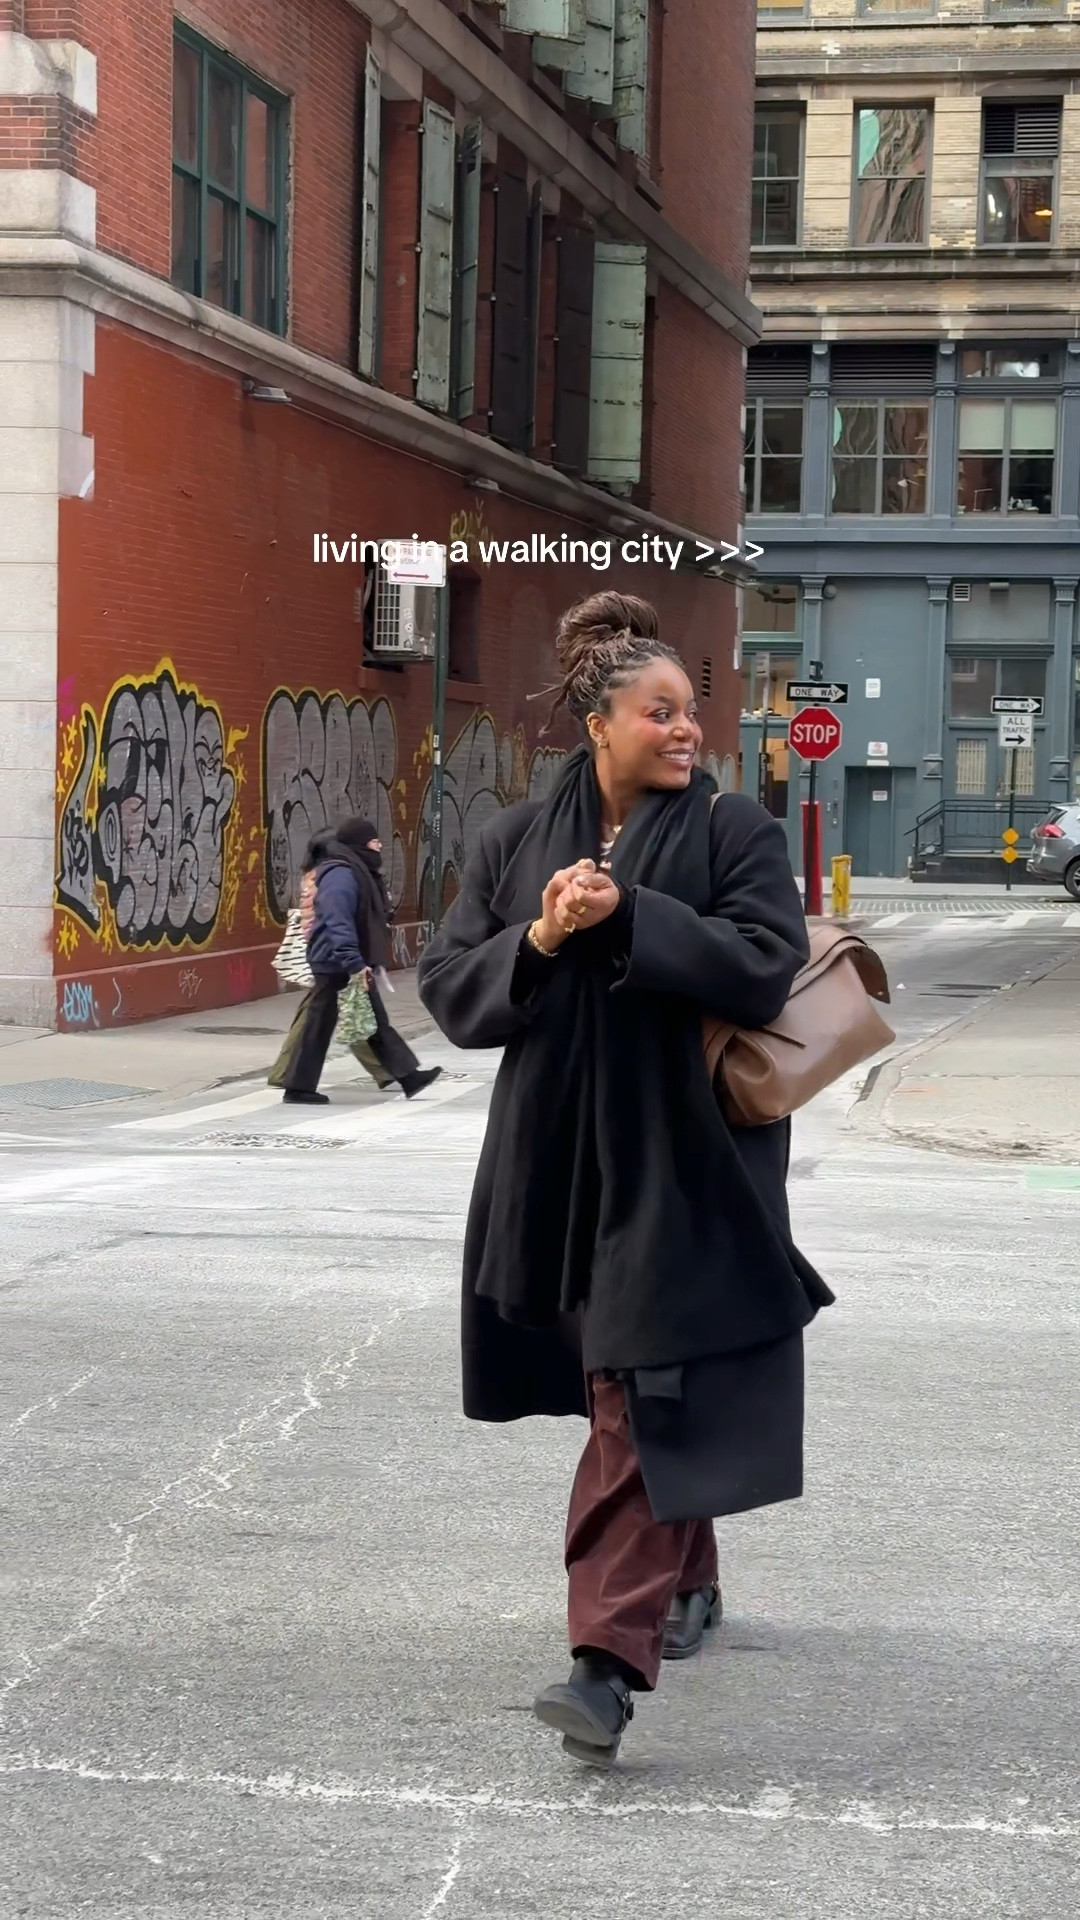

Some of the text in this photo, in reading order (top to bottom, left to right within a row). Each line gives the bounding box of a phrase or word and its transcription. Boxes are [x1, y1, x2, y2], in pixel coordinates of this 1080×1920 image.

[795, 688, 839, 697] ONE WAY
[1007, 717, 1026, 726] ALL
[792, 723, 838, 744] STOP
[1002, 726, 1031, 734] TRAFFIC
